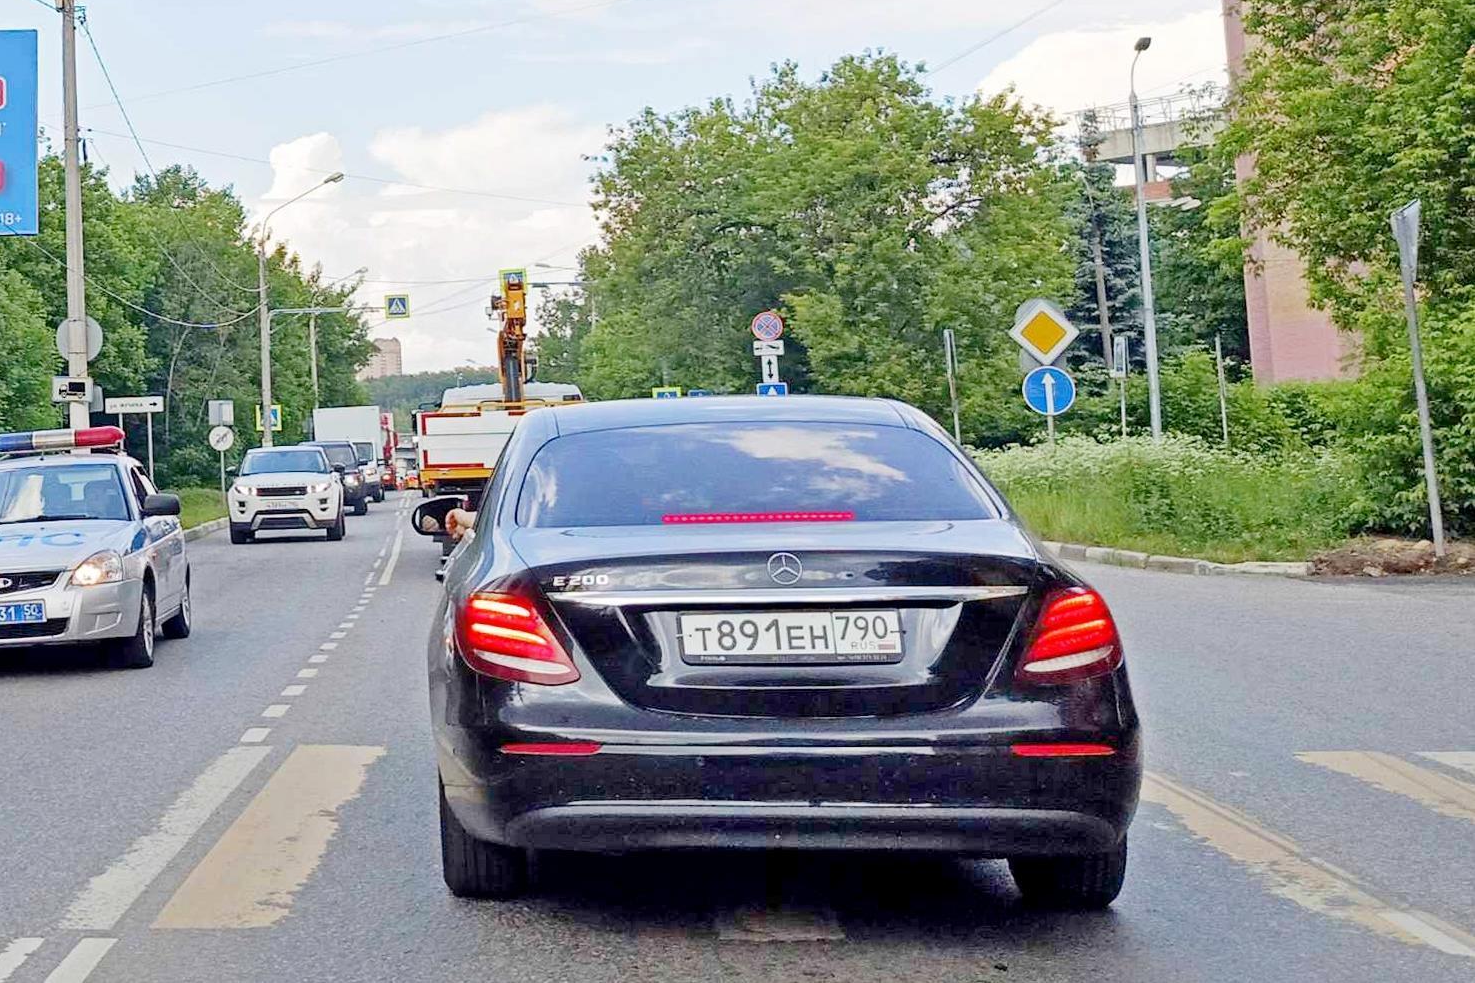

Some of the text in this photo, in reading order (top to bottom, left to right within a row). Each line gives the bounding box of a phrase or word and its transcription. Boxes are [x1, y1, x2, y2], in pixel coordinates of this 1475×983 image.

[552, 574, 609, 587] E 200
[834, 615, 889, 641] 790
[850, 640, 877, 651] RUS
